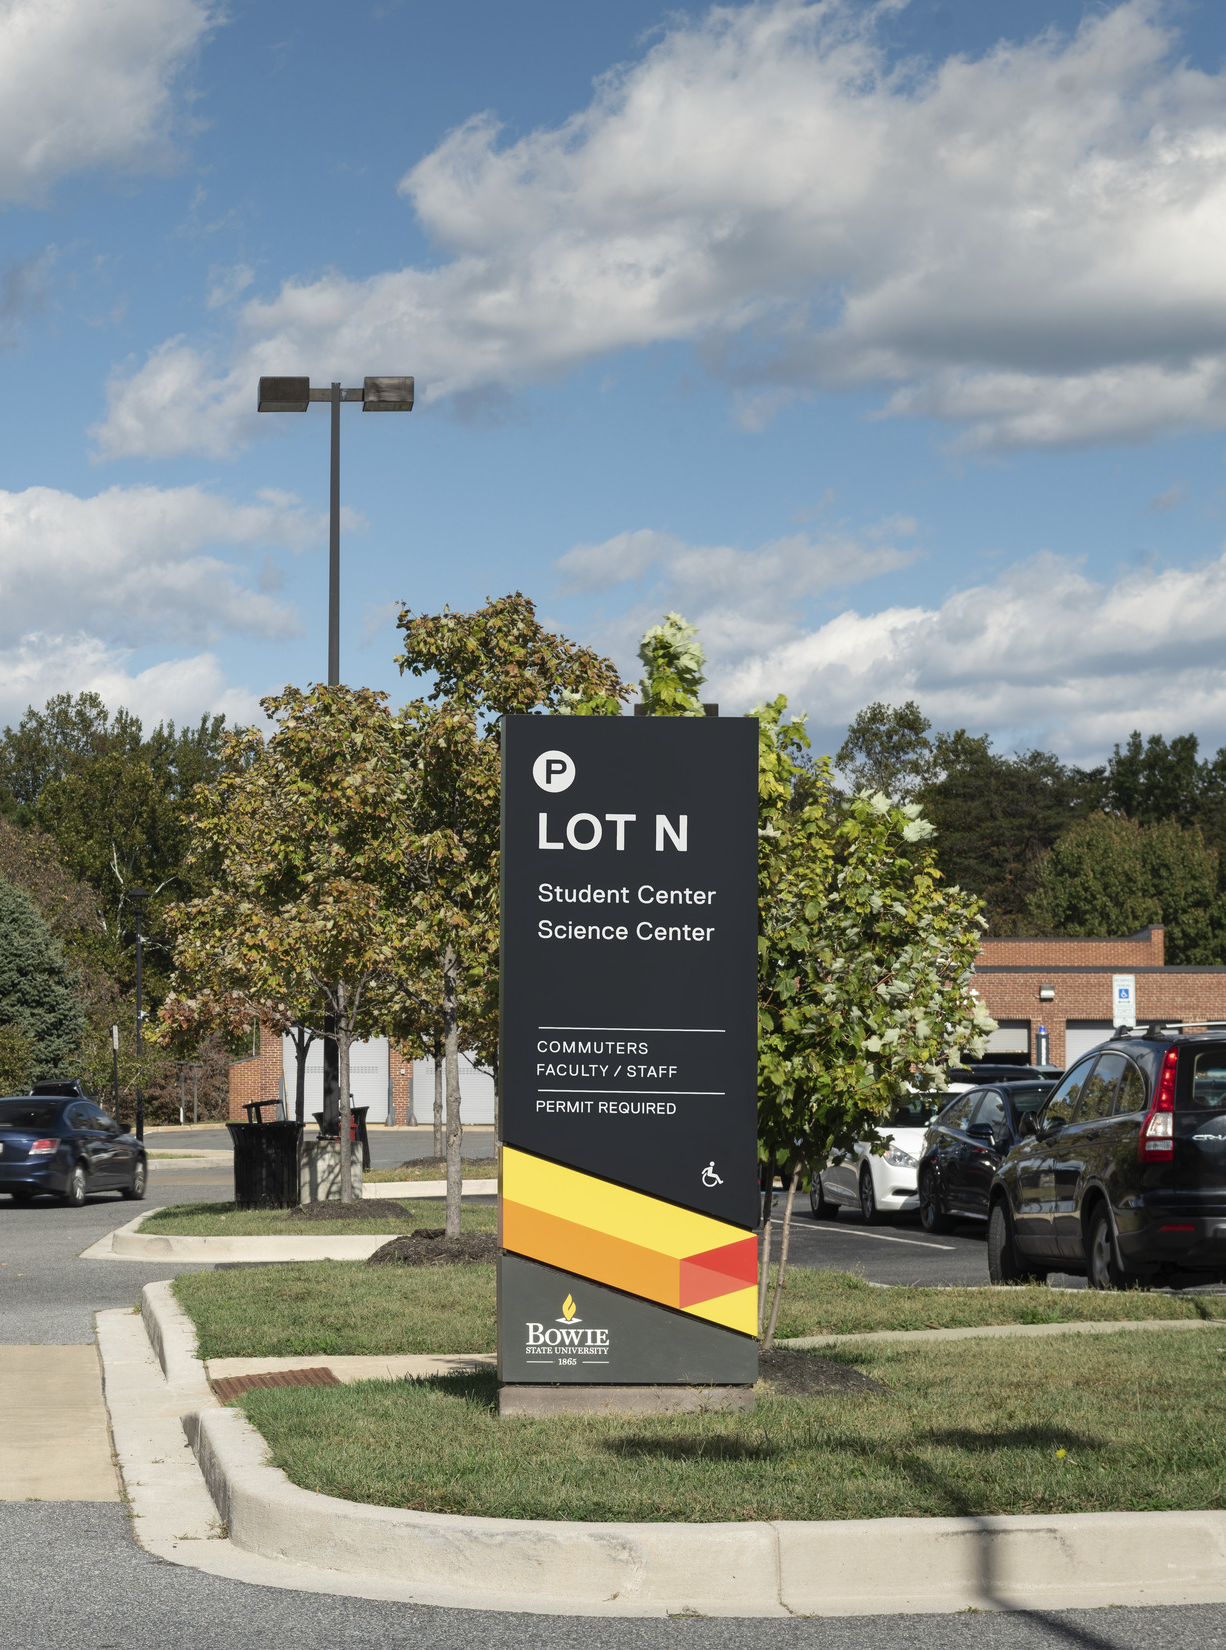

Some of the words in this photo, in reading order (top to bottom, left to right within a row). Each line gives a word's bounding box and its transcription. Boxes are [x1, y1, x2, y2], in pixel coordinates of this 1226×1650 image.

[545, 758, 568, 785] P
[538, 812, 637, 851] LOT
[655, 814, 688, 852] N
[537, 882, 630, 904] Student
[637, 884, 717, 905] Center
[537, 919, 629, 941] Science
[636, 921, 716, 942] Center
[536, 1040, 649, 1055] COMMUTERS
[536, 1063, 609, 1077] FACULTY
[626, 1064, 678, 1079] STAFF
[536, 1100, 594, 1114] PERMIT
[598, 1101, 677, 1116] REQUIRED
[525, 1322, 610, 1346] BOWIE
[525, 1346, 553, 1354] STATE
[554, 1346, 610, 1355] UNIVERSITY
[558, 1358, 577, 1366] 1865
